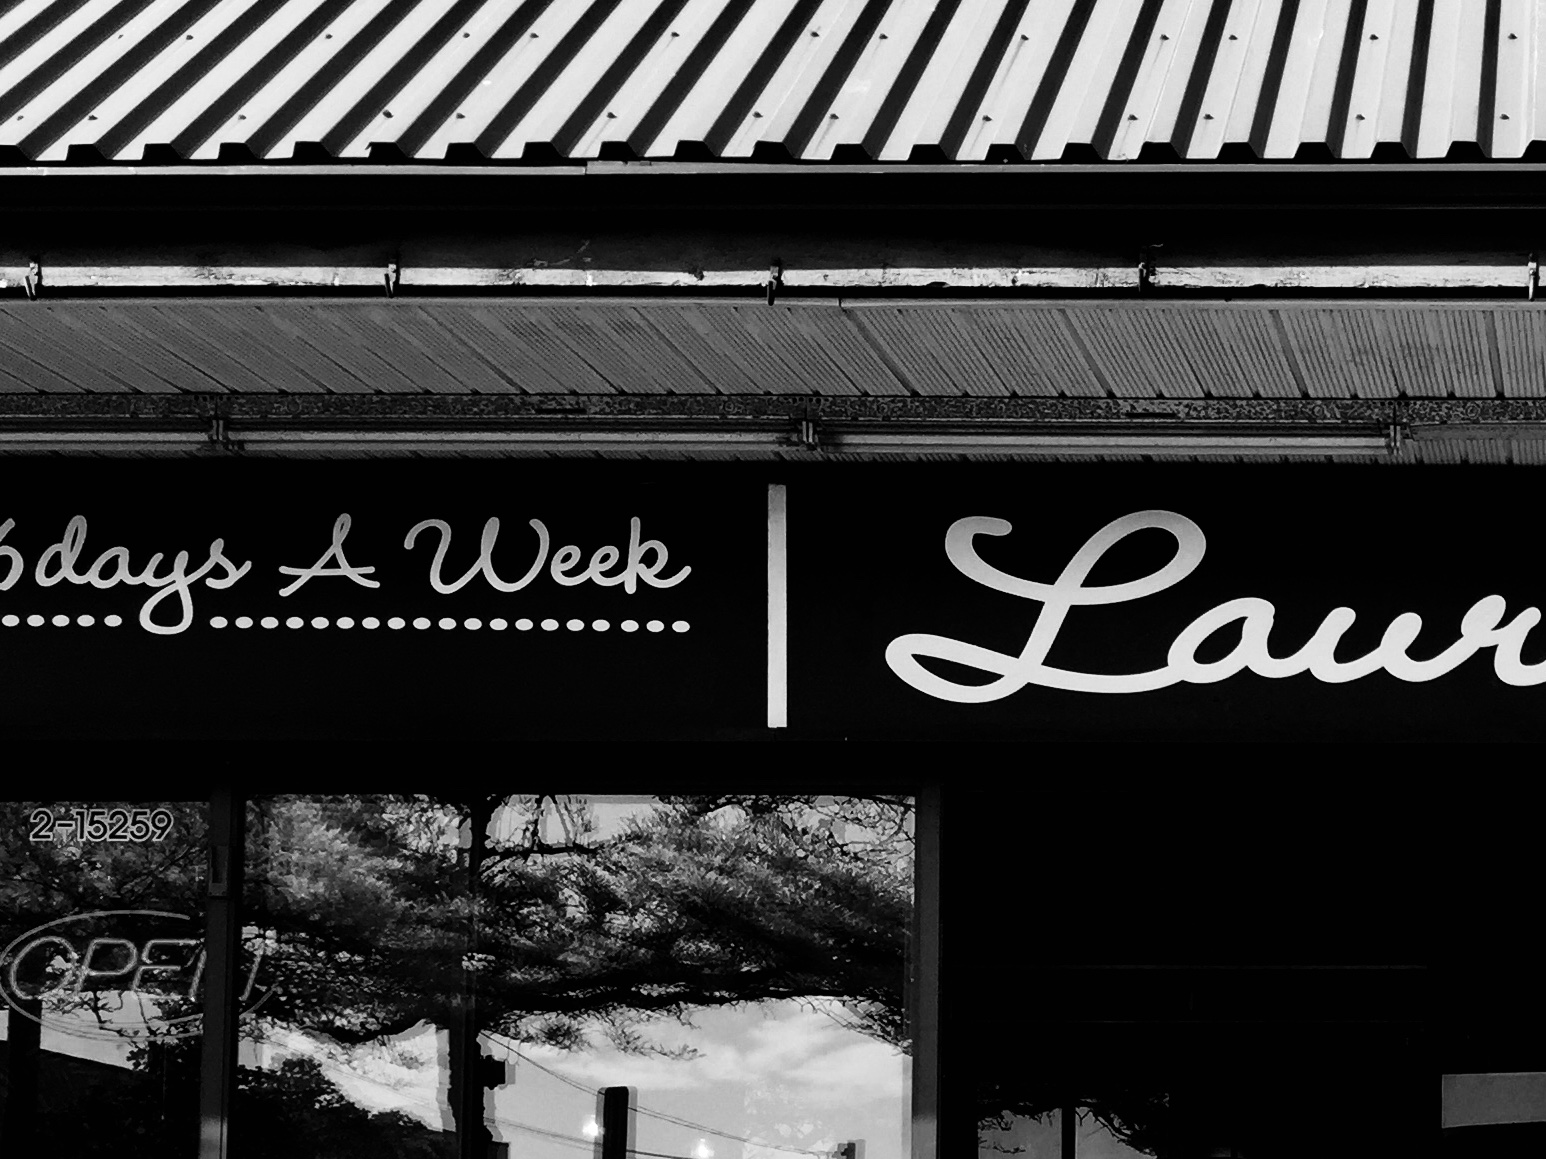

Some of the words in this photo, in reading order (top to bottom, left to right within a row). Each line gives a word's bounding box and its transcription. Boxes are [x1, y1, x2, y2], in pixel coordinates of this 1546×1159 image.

[279, 513, 380, 596] A
[404, 516, 691, 594] Week
[30, 807, 174, 842] 2-15259
